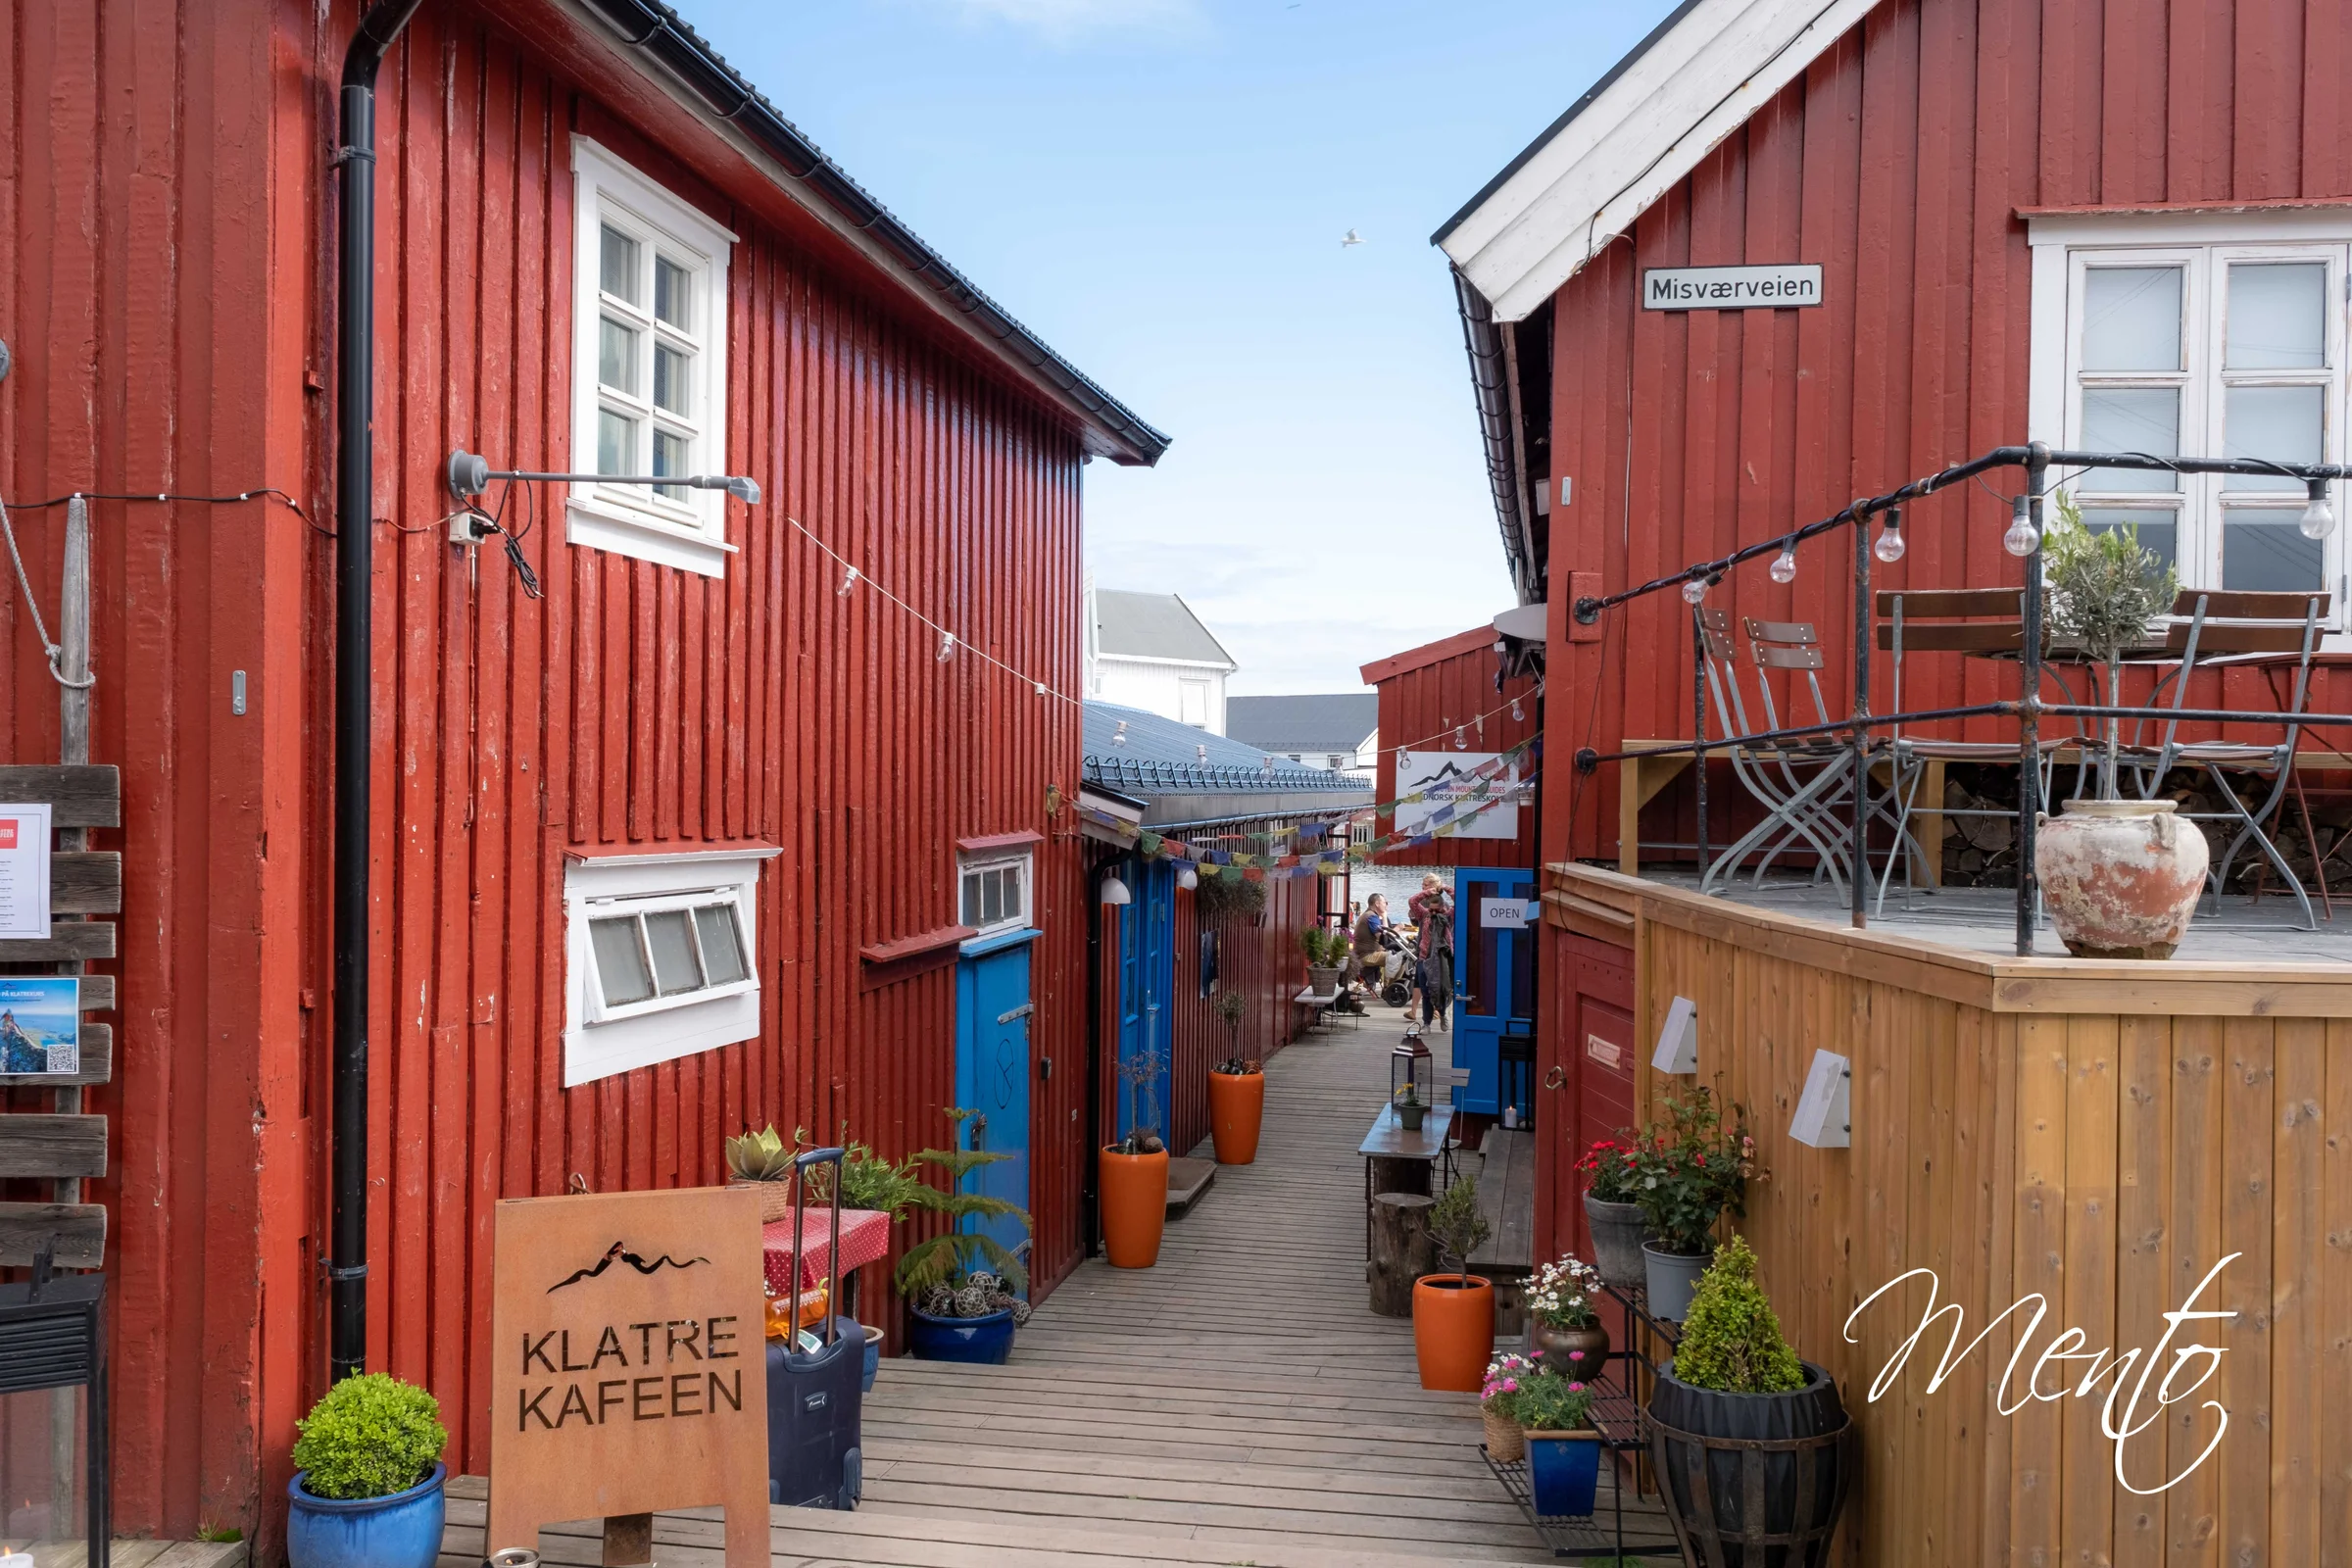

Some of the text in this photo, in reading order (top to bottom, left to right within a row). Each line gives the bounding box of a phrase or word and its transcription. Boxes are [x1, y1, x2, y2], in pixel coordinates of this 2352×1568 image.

[1652, 275, 1813, 300] Misværveien
[1490, 907, 1520, 918] OPEN
[522, 1315, 739, 1376] KLATRE
[518, 1369, 742, 1432] KAFEEN
